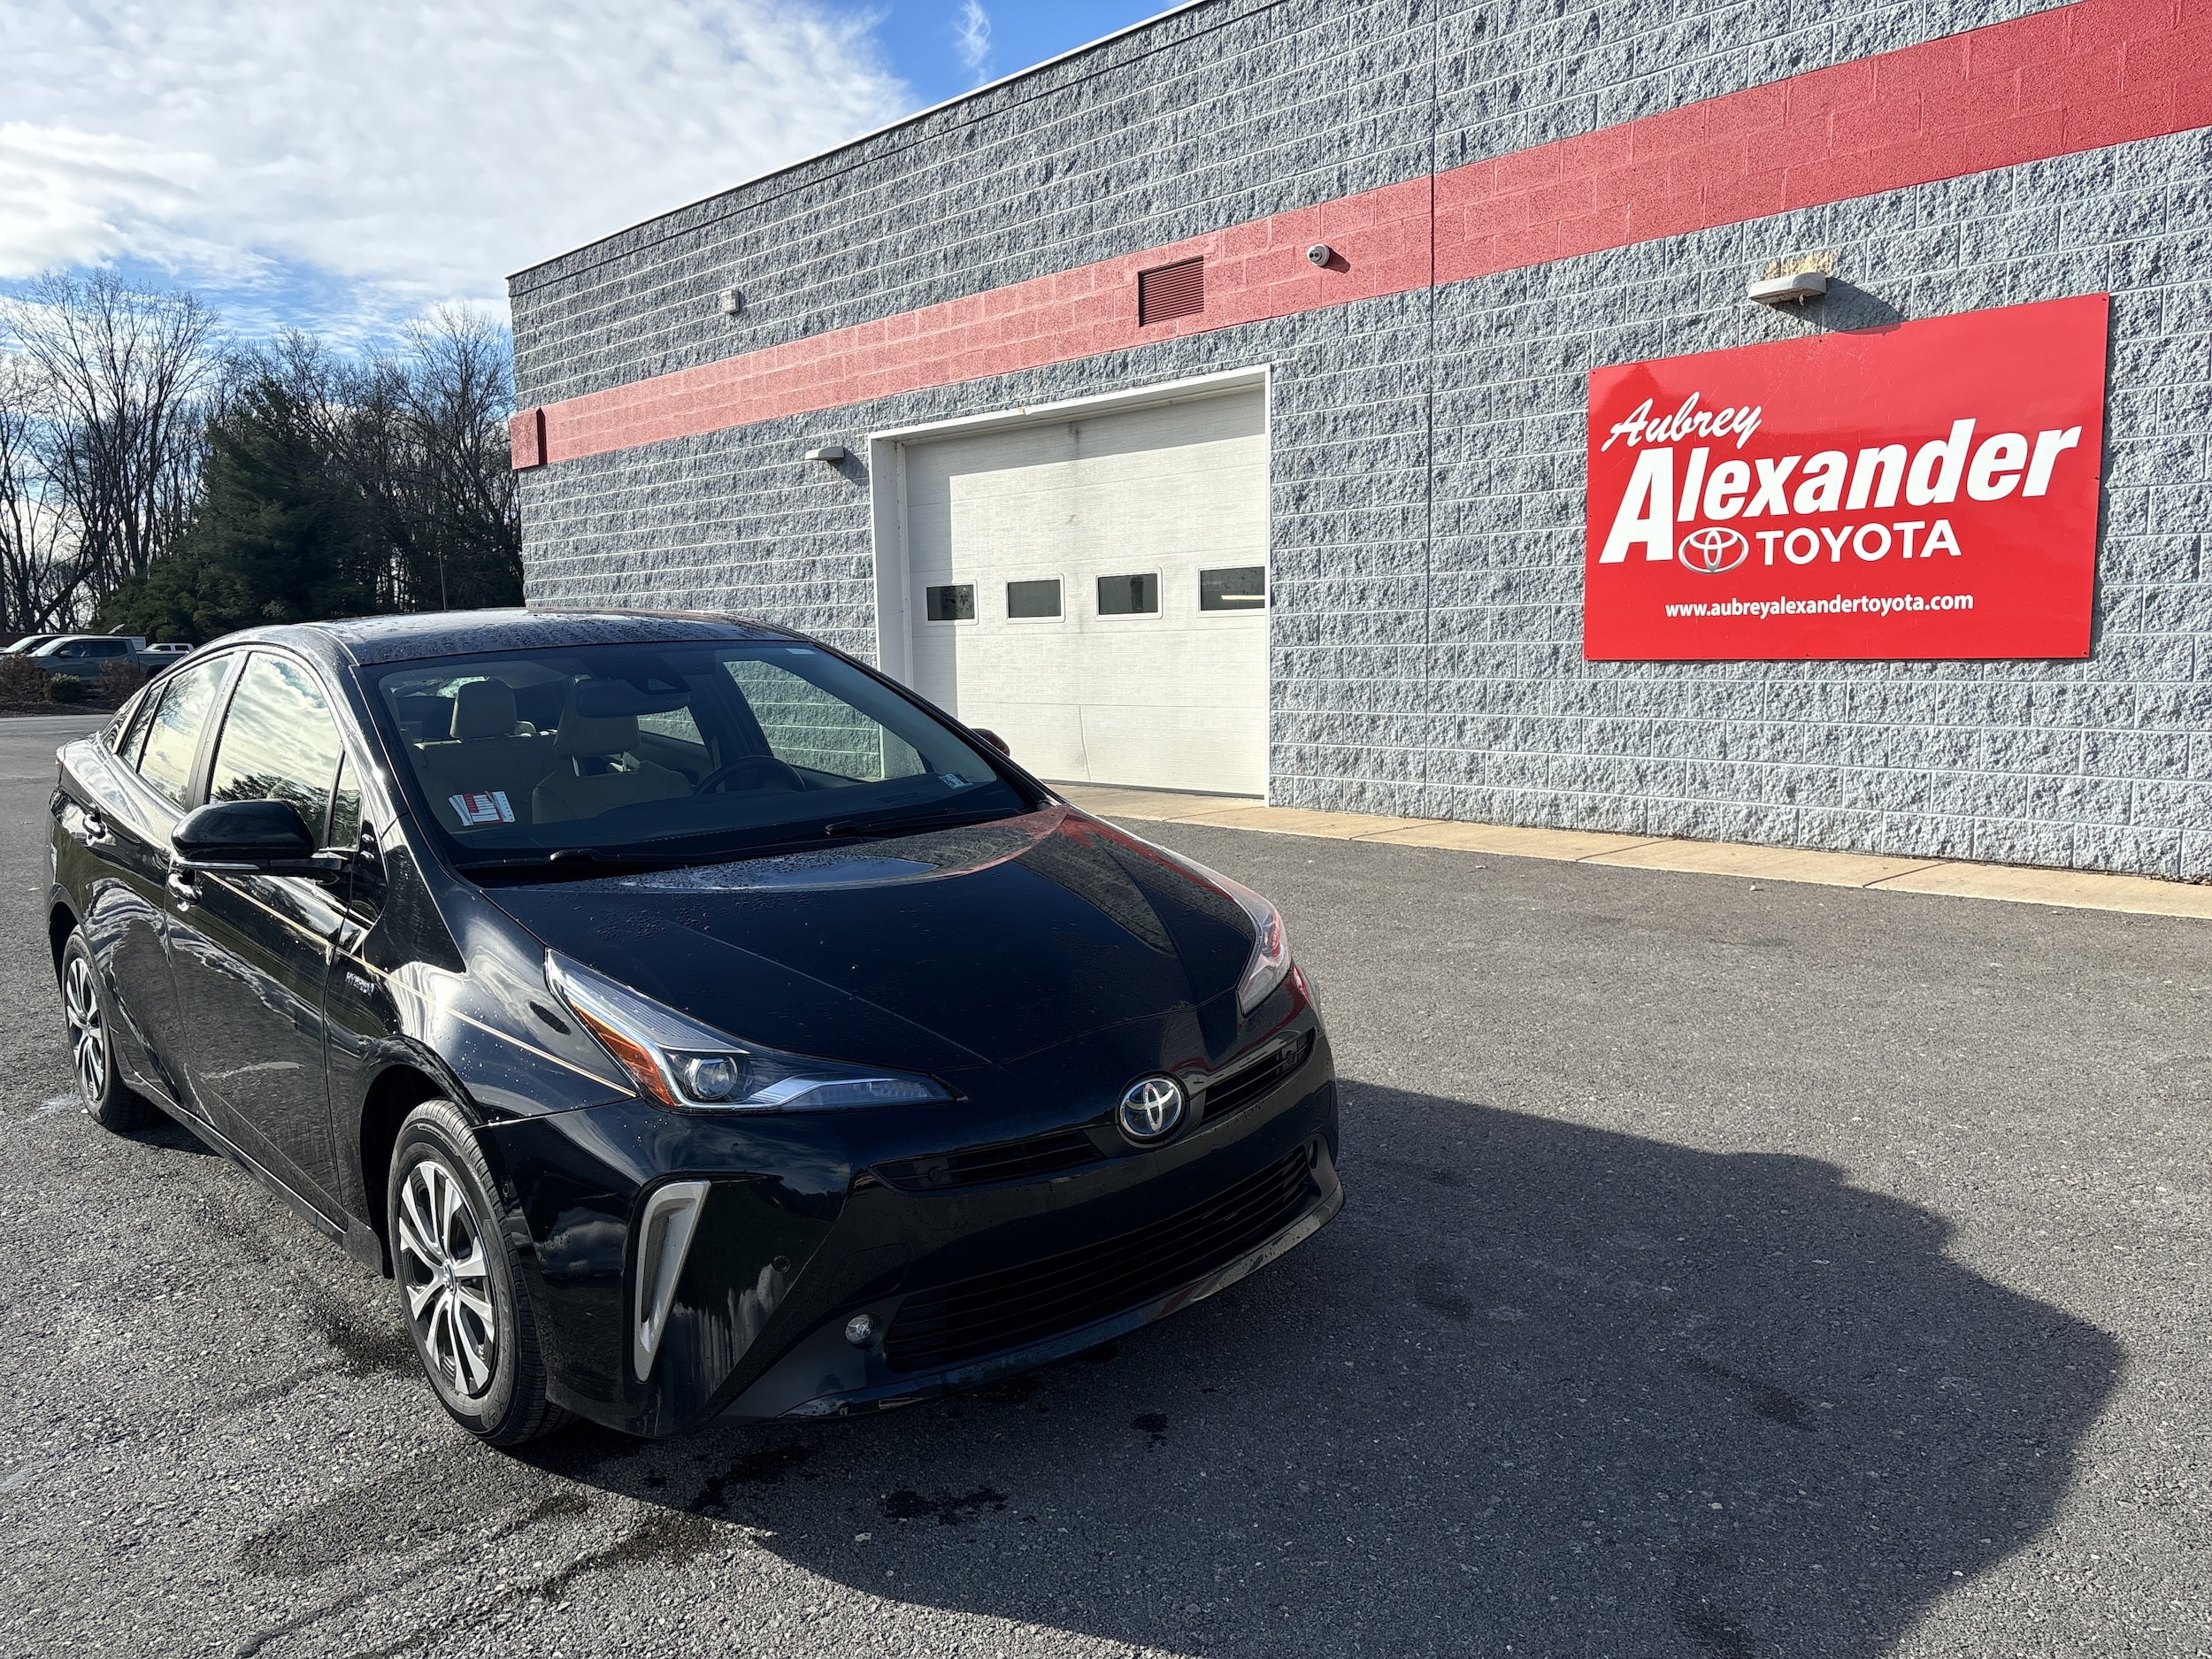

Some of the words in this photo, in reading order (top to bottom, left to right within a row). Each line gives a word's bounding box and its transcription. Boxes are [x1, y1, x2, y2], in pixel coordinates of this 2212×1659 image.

[1601, 391, 1763, 452] Aubrey
[1598, 418, 2082, 564] Alexander
[1755, 519, 1962, 565] TOYOTA
[1665, 593, 1974, 620] www.aubreyalexandertoyota.com
